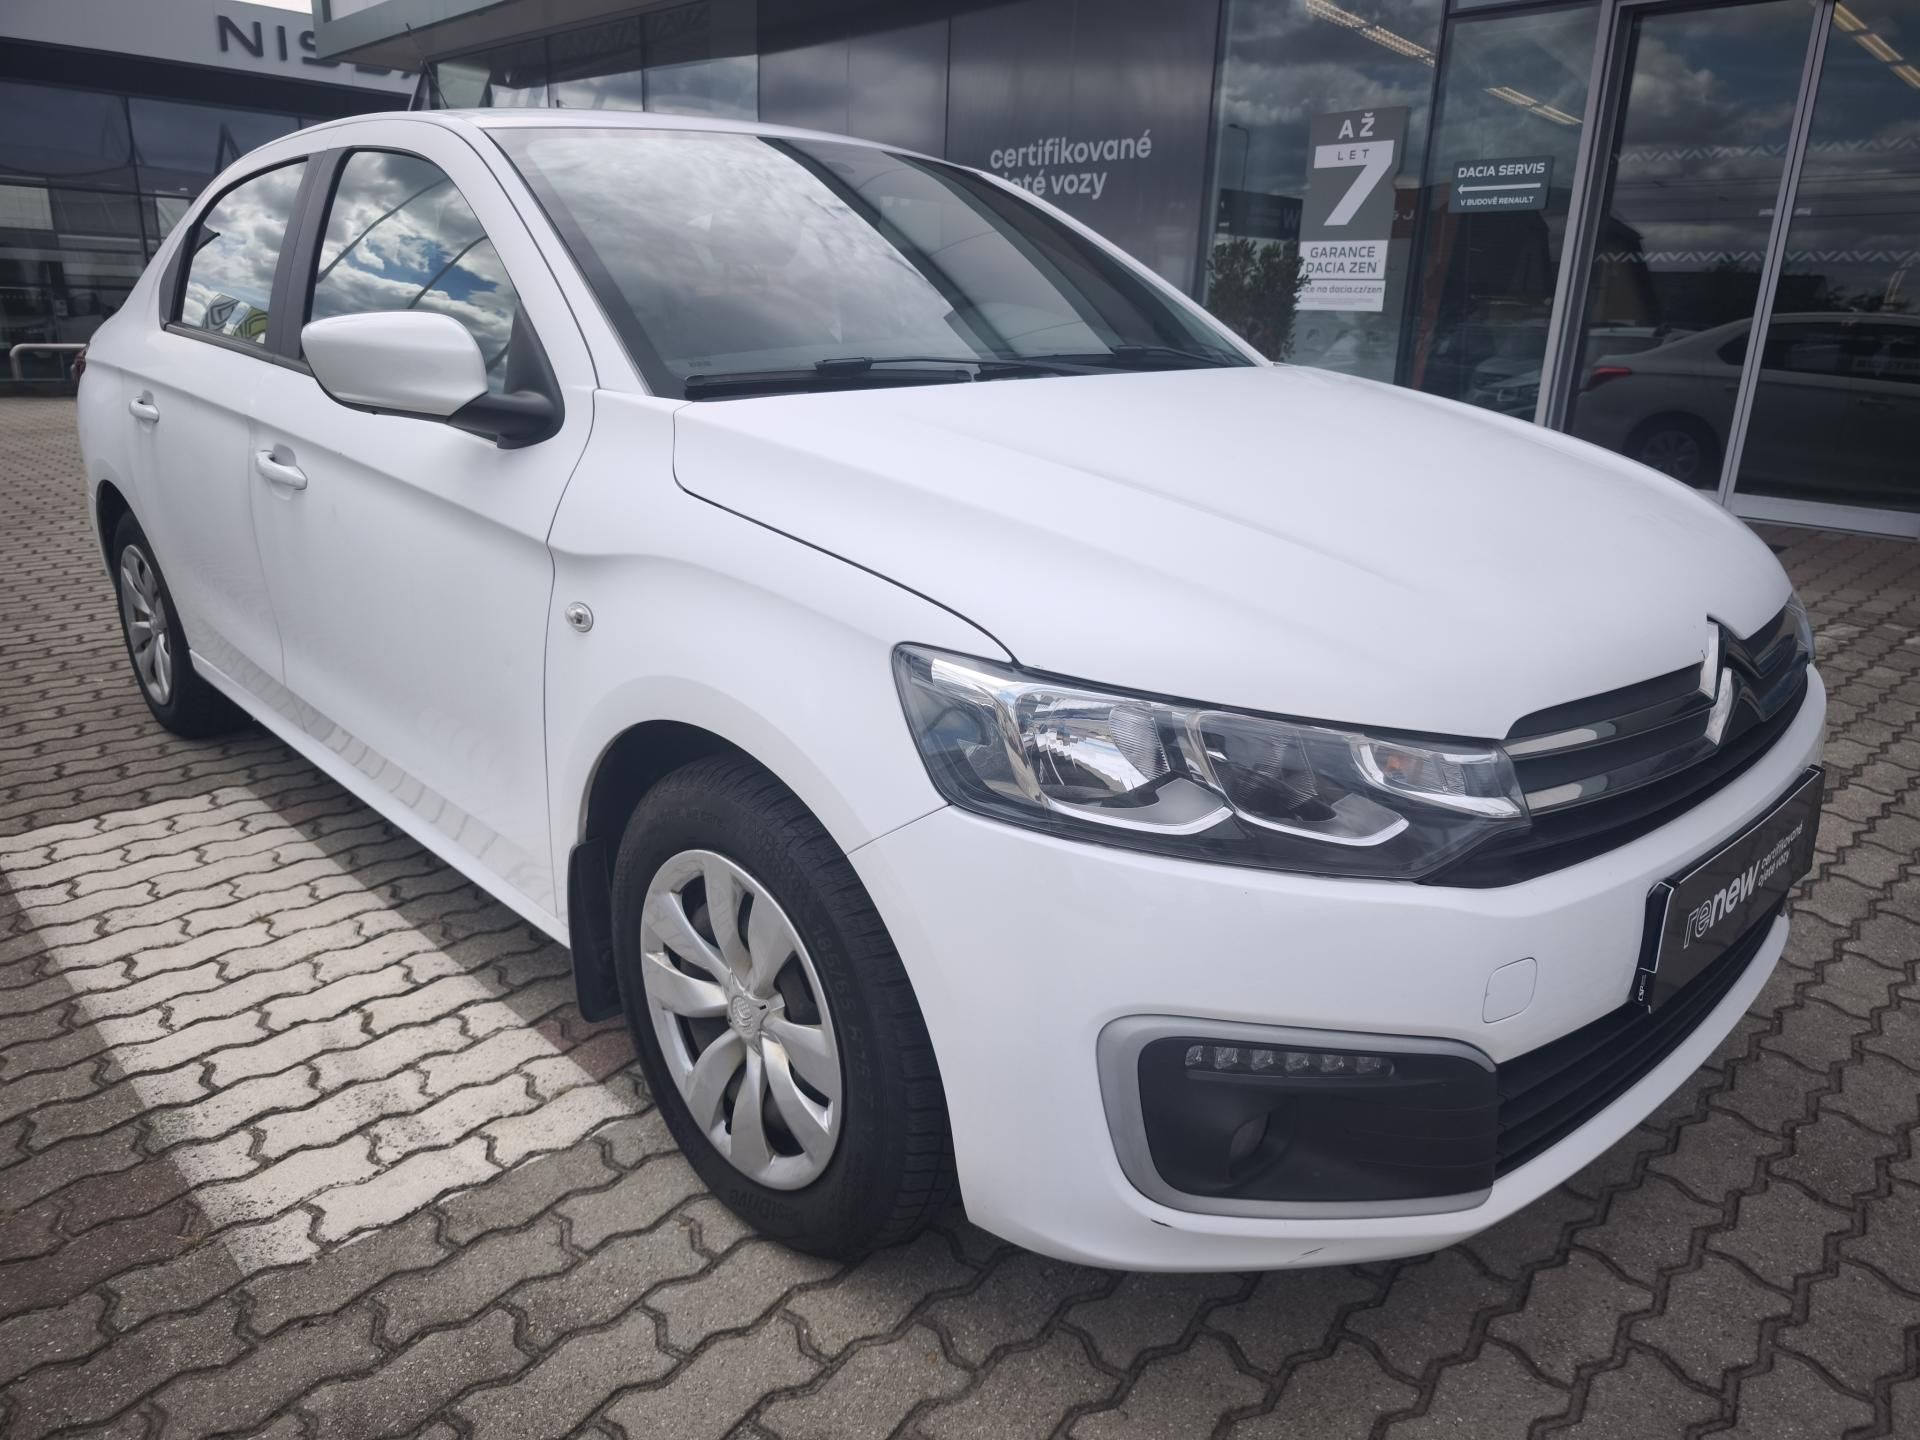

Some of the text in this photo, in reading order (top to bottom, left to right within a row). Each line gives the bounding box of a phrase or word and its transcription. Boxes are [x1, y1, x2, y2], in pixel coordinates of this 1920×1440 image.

[1338, 112, 1375, 139] AŽ
[990, 129, 1152, 169] certifikované
[1337, 149, 1370, 161] LET
[1457, 162, 1545, 178] DACIA SERVIS
[1051, 172, 1108, 200] vozy
[1313, 139, 1395, 226] 7
[1498, 196, 1534, 205] RENAULT
[1310, 246, 1376, 258] GARANCE
[1305, 261, 1377, 274] DACIA ZEN
[1683, 859, 1760, 949] renew
